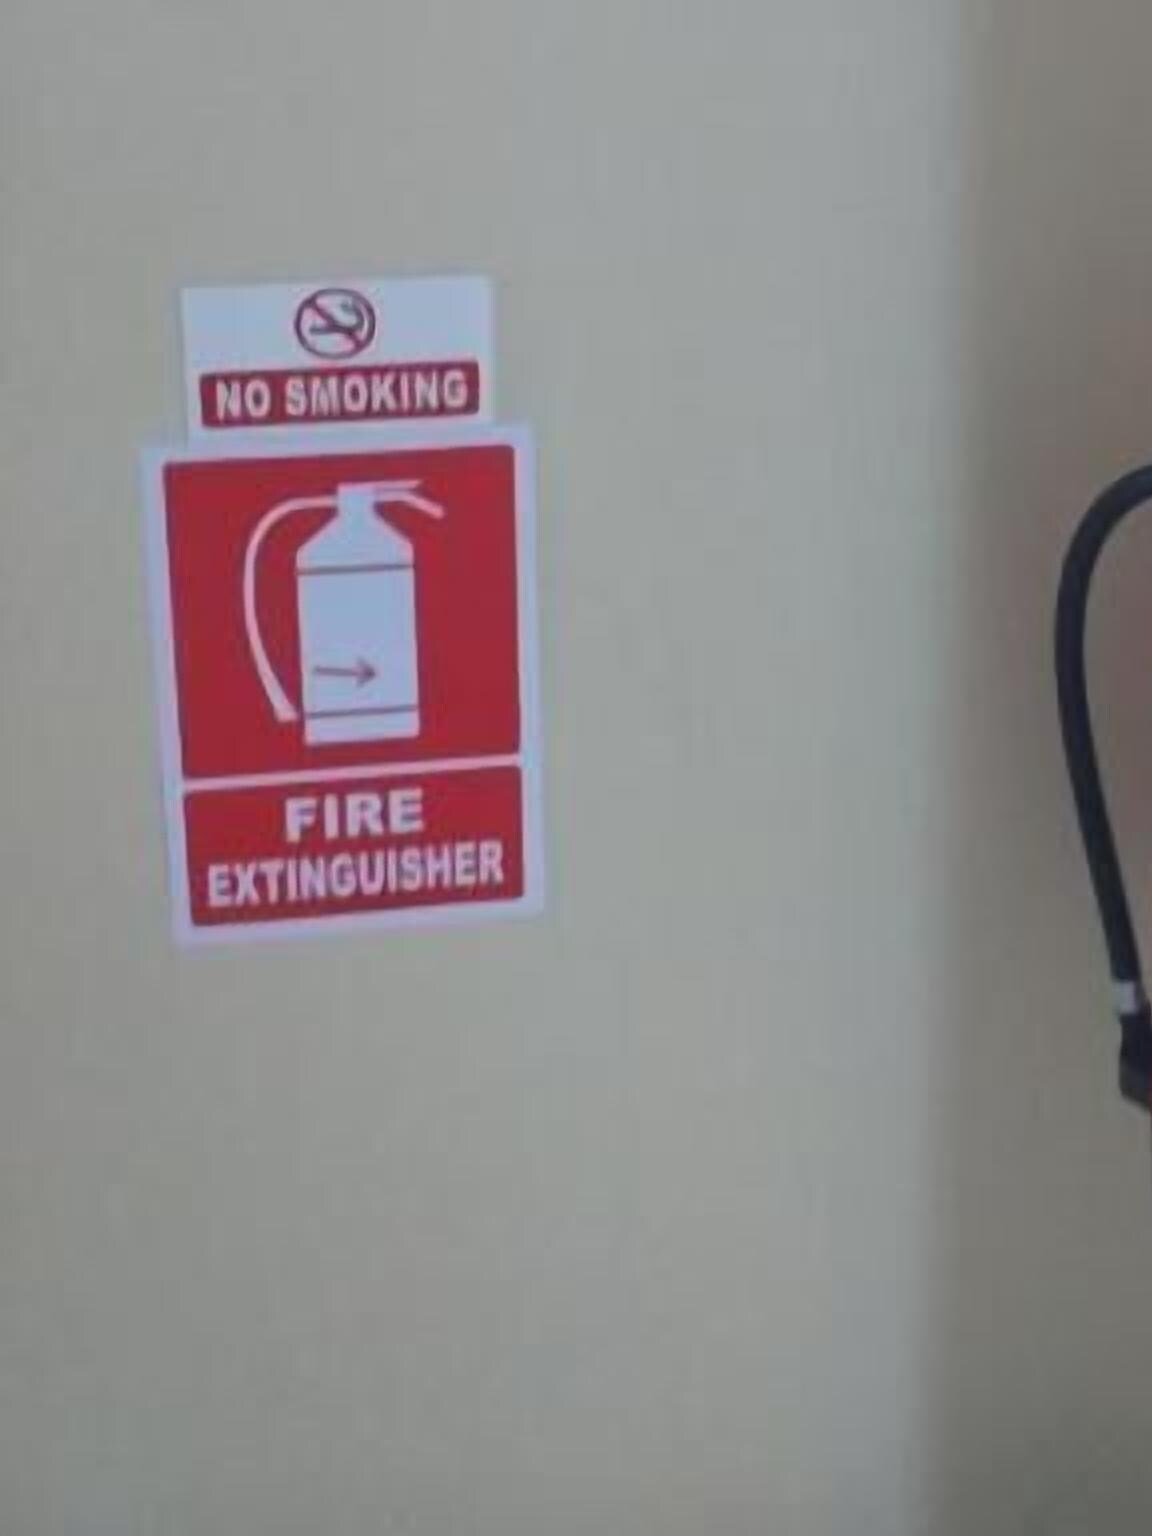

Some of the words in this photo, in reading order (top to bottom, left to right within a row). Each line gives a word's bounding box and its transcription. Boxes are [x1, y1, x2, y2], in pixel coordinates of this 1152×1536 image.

[215, 378, 272, 420] NO
[284, 369, 469, 417] SMOKING
[284, 788, 424, 843] FIRE
[206, 839, 505, 908] EXTINGUISHER
